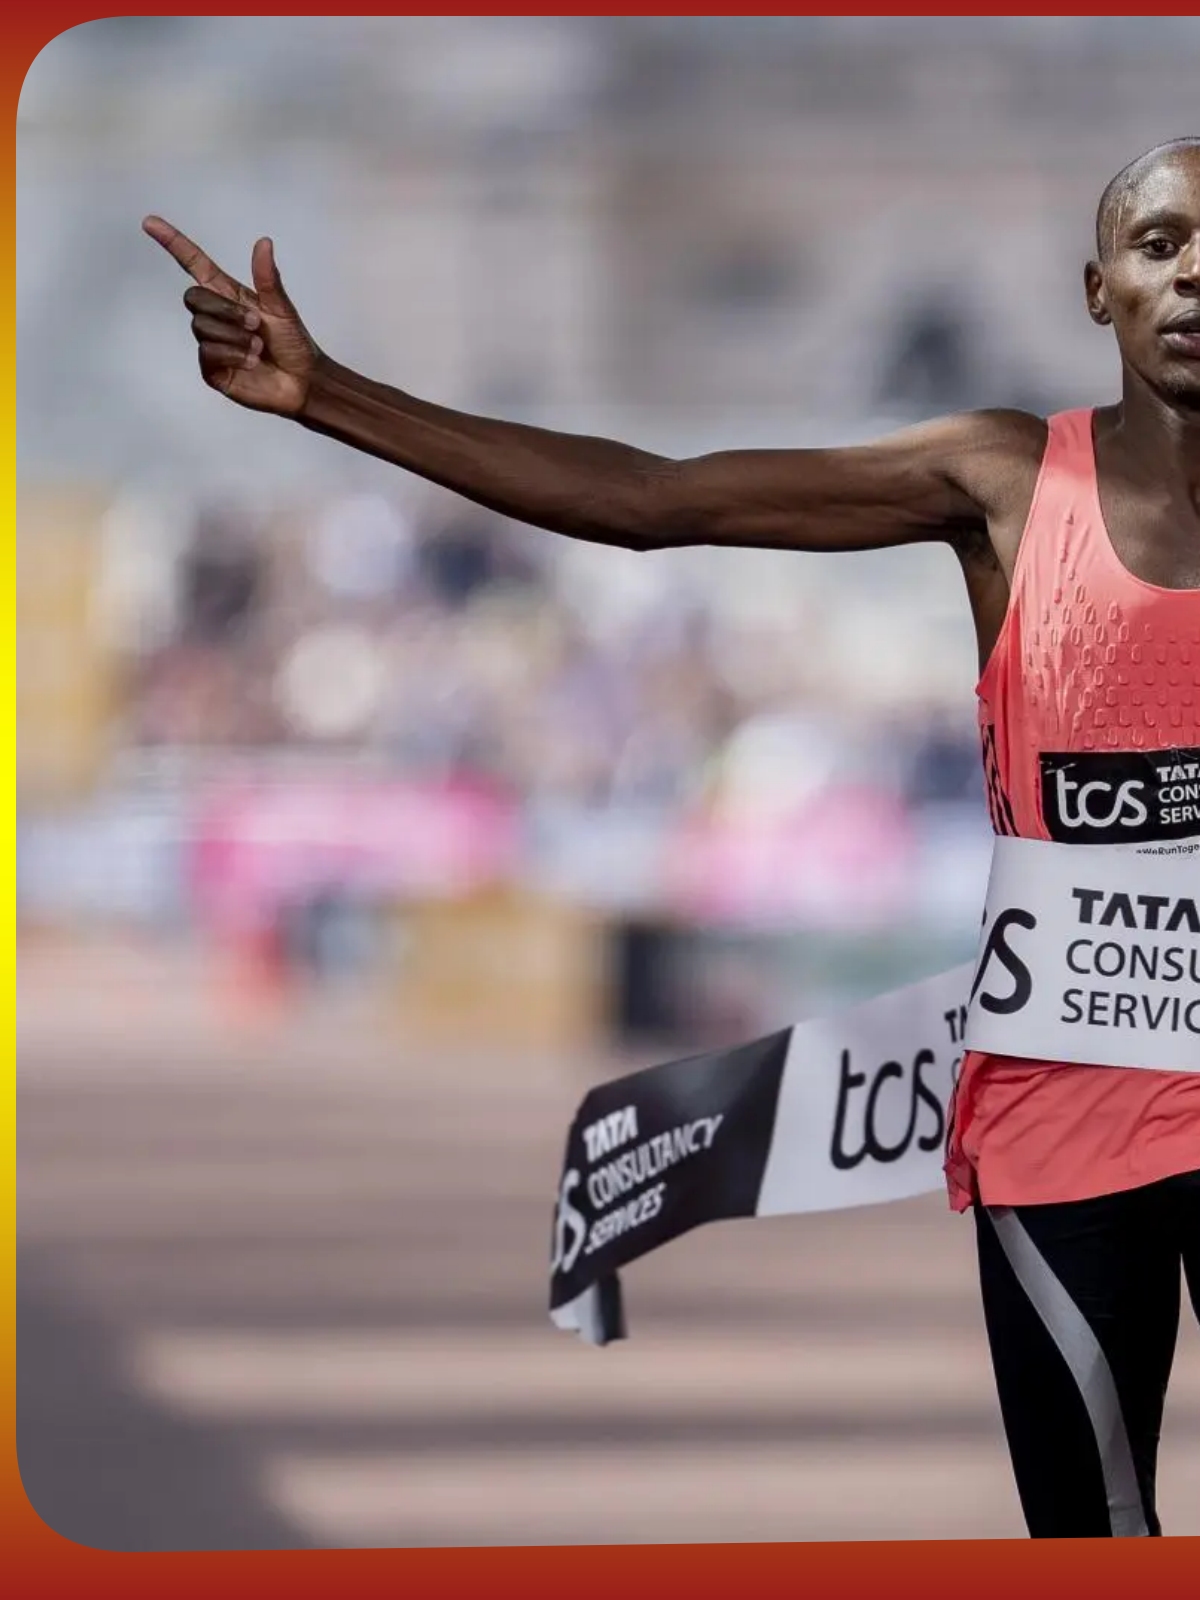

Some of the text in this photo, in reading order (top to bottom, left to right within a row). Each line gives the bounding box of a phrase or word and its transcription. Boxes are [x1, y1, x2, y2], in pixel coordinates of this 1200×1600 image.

[1056, 768, 1147, 828] tcs
[582, 1105, 638, 1163] TATA
[830, 1049, 945, 1169] tcs
[587, 1114, 724, 1209] CONSULTANCY
[585, 1182, 667, 1255] SERVICES
